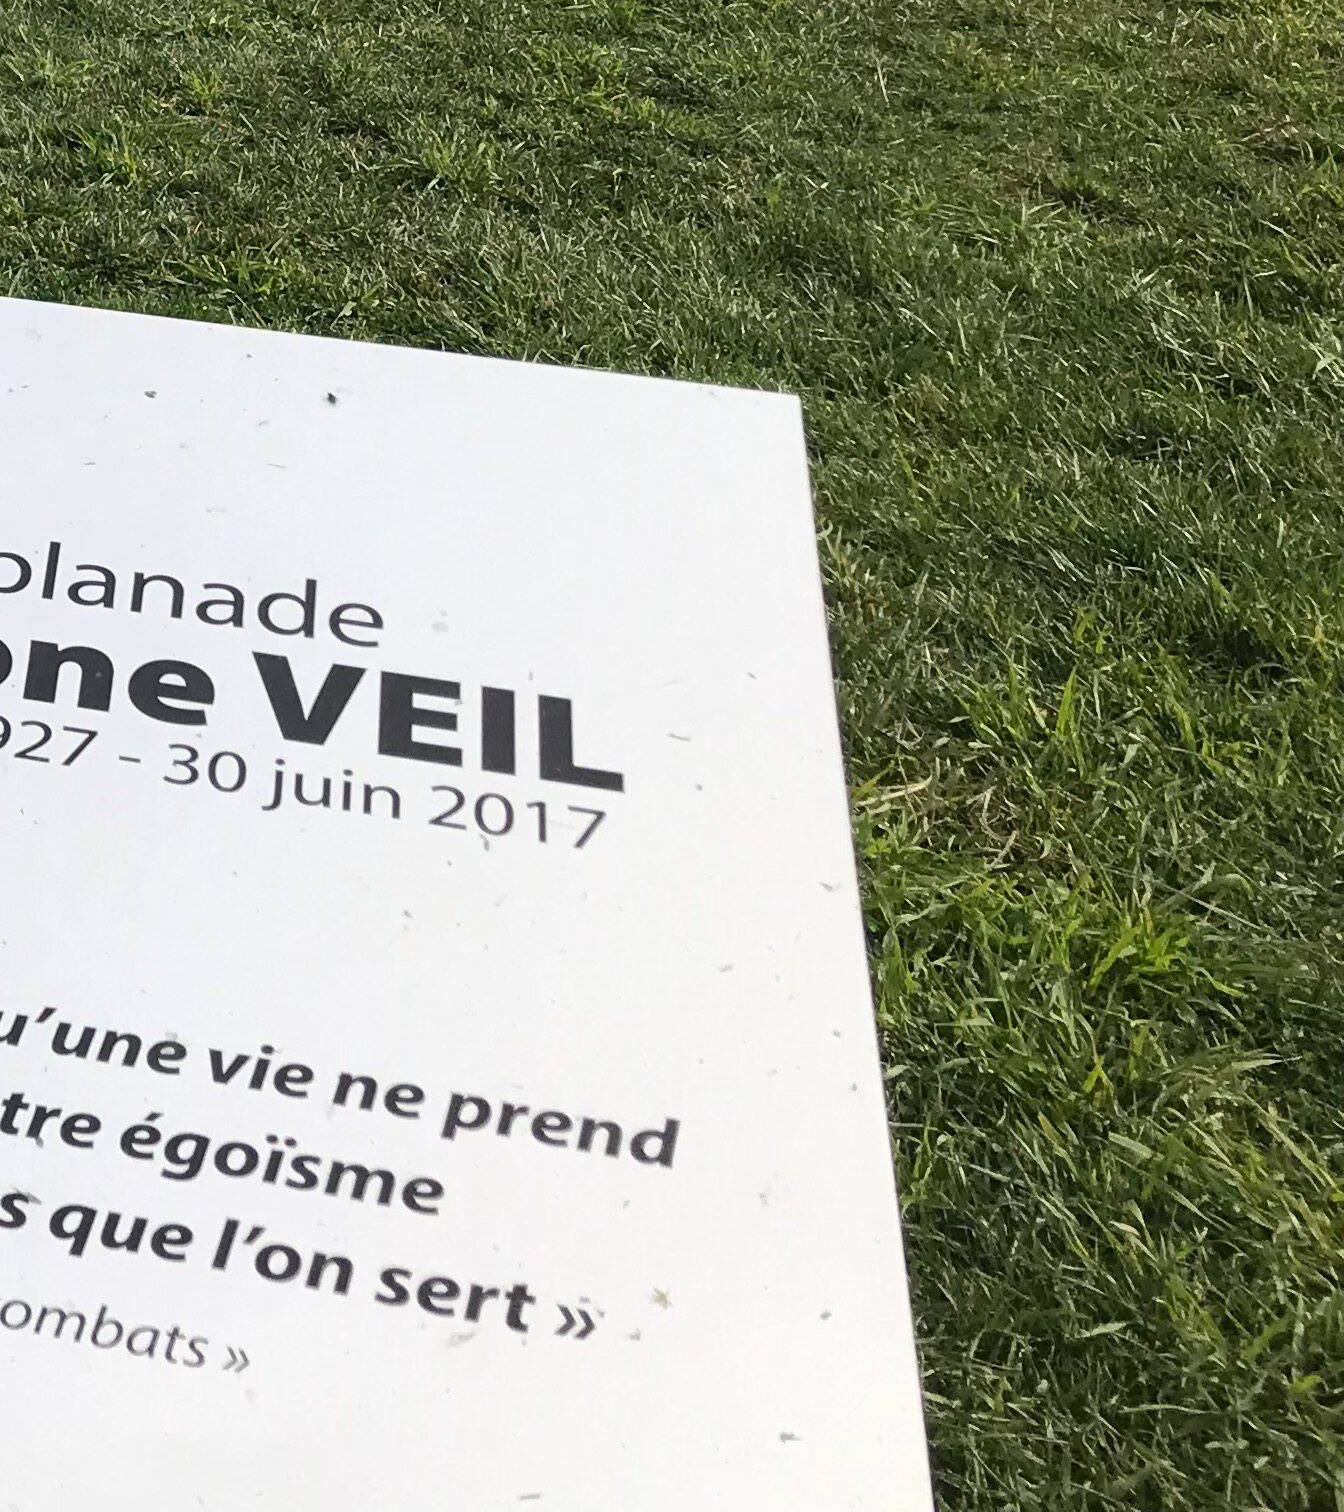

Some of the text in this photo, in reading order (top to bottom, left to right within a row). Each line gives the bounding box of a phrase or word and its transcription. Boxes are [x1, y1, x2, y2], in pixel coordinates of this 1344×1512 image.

[251, 650, 626, 794] VEIL
[162, 743, 248, 793] 30
[260, 758, 401, 820] juin
[428, 784, 607, 850] 2017
[119, 1110, 445, 1216] égoïsme
[208, 1043, 315, 1099] vie
[331, 1071, 426, 1120] ne
[440, 1091, 681, 1169] prend
[48, 1203, 195, 1263] que
[373, 1266, 537, 1334] sert
